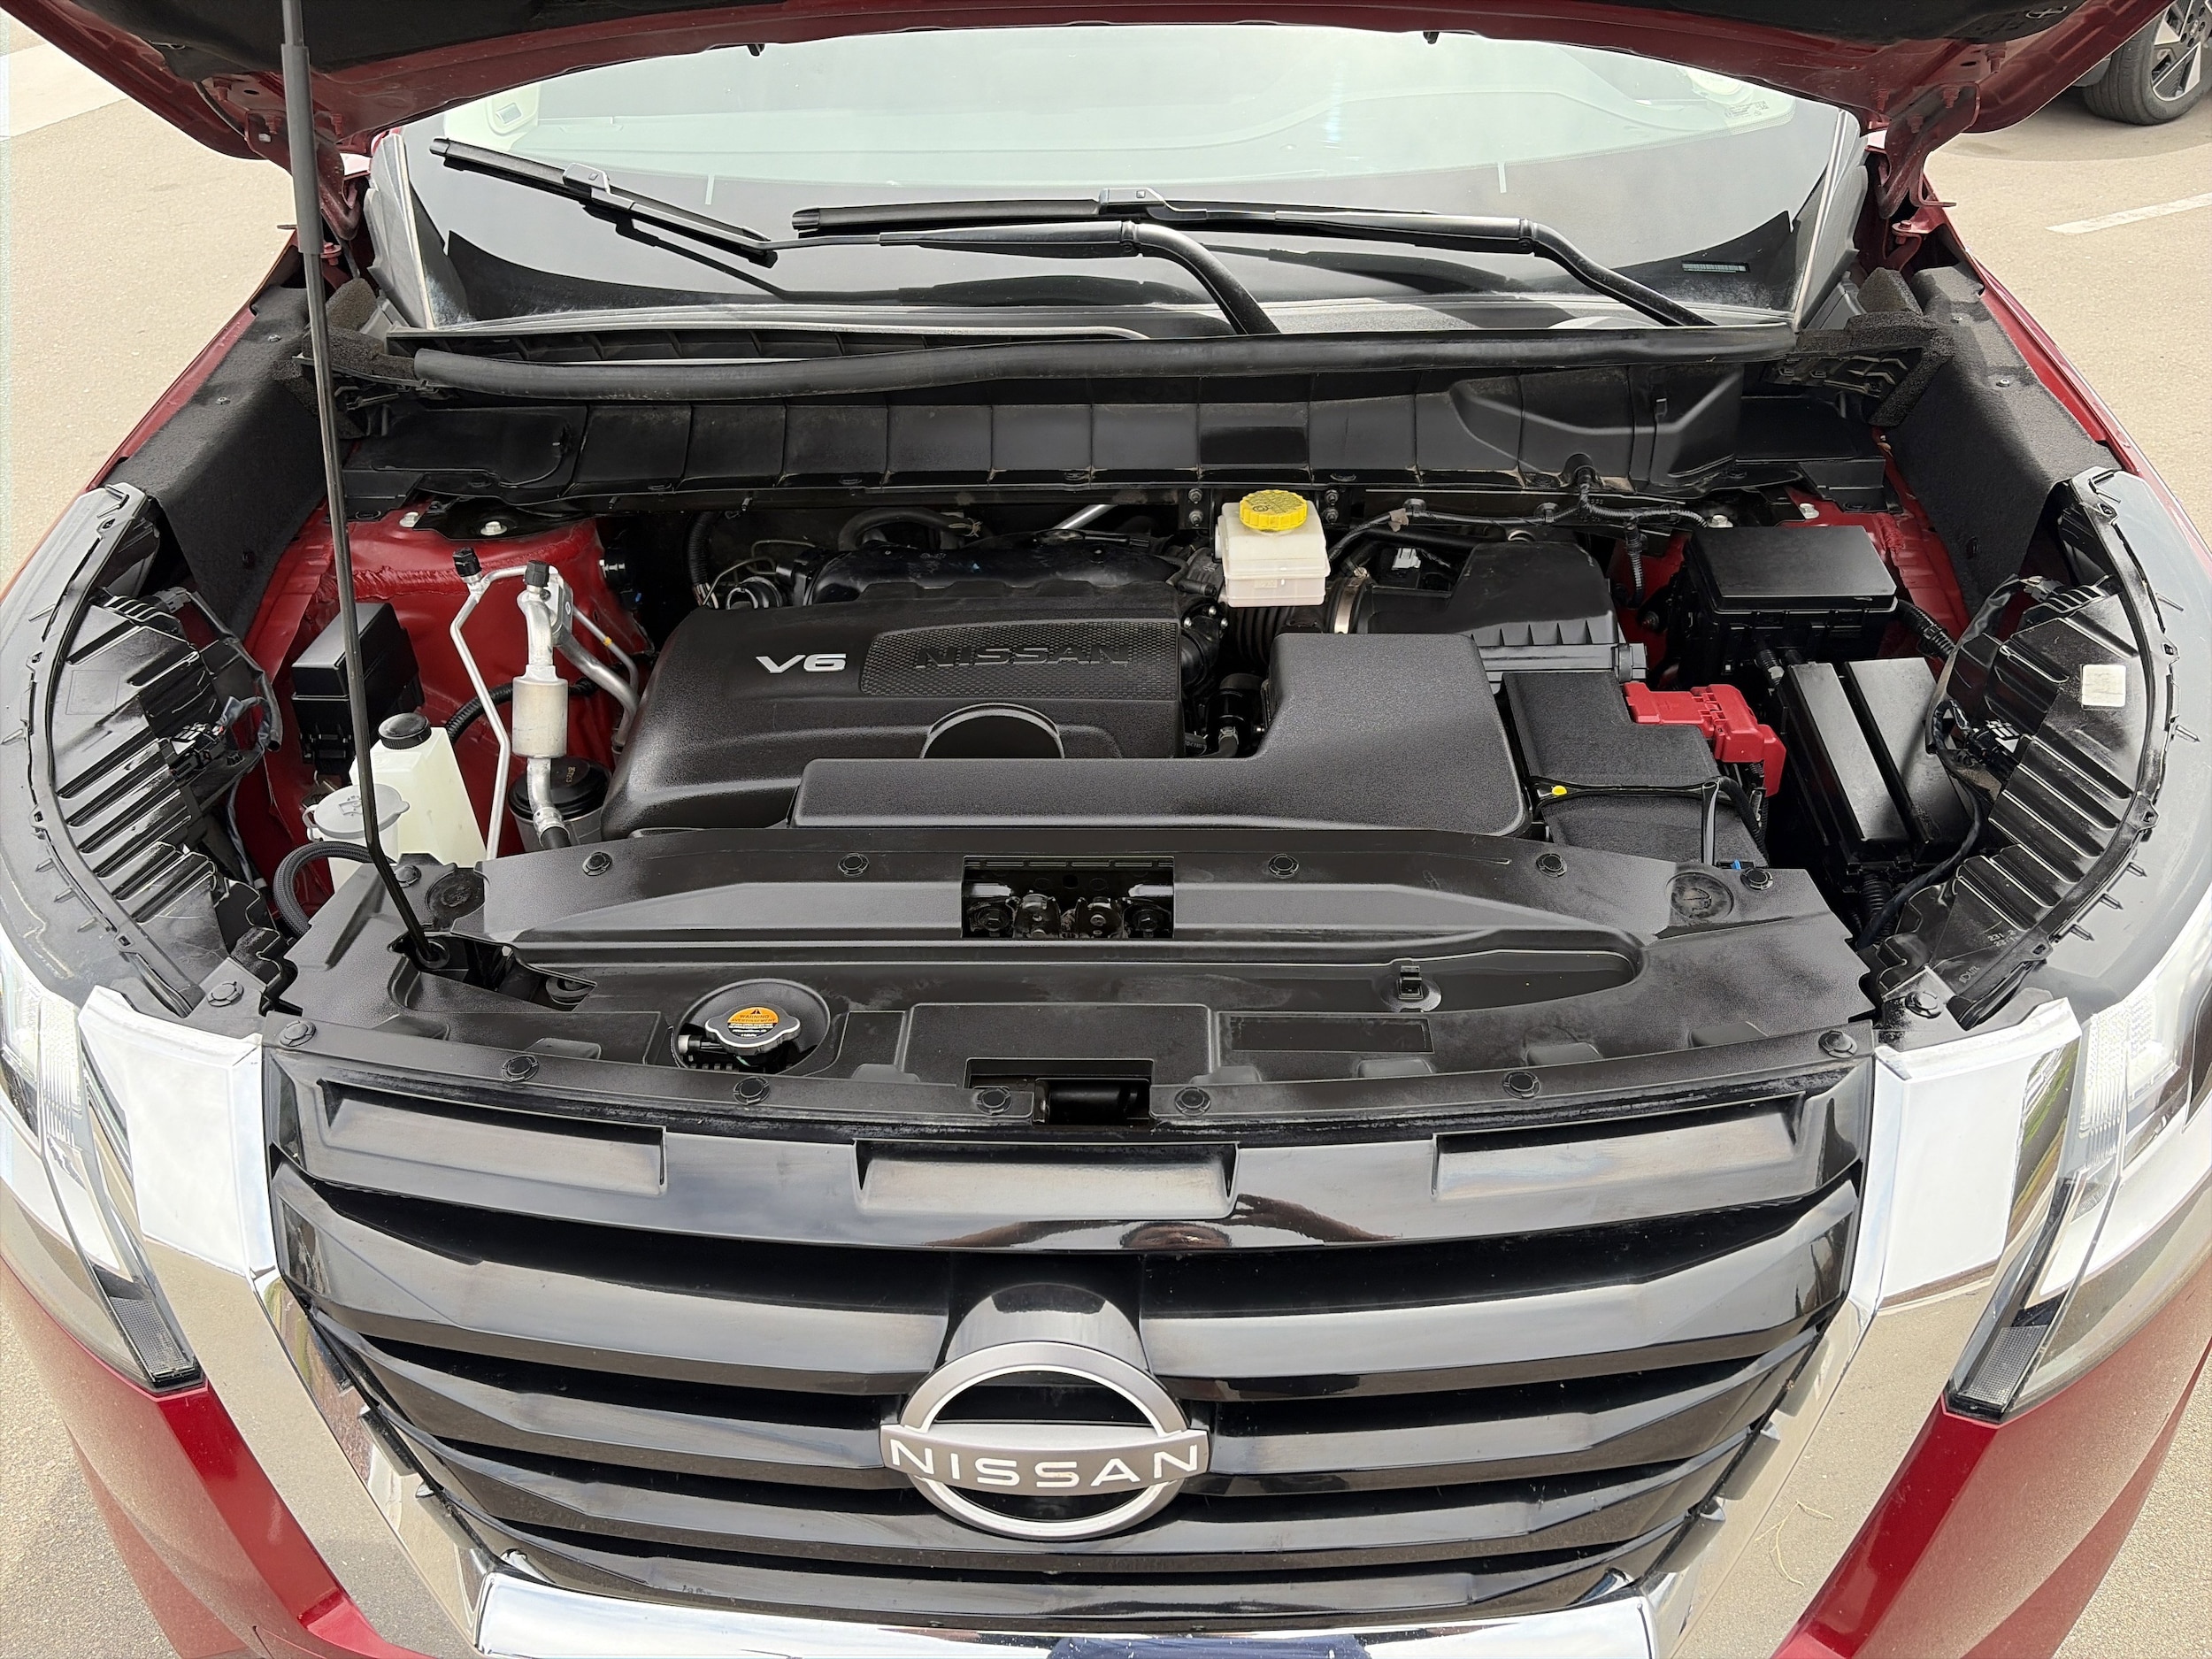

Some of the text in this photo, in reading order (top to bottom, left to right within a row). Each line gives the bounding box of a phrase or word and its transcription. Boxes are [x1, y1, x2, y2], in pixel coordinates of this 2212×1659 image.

[756, 653, 848, 674] V6
[915, 644, 1129, 669] NISSAN
[889, 1439, 1198, 1488] NISSAN
